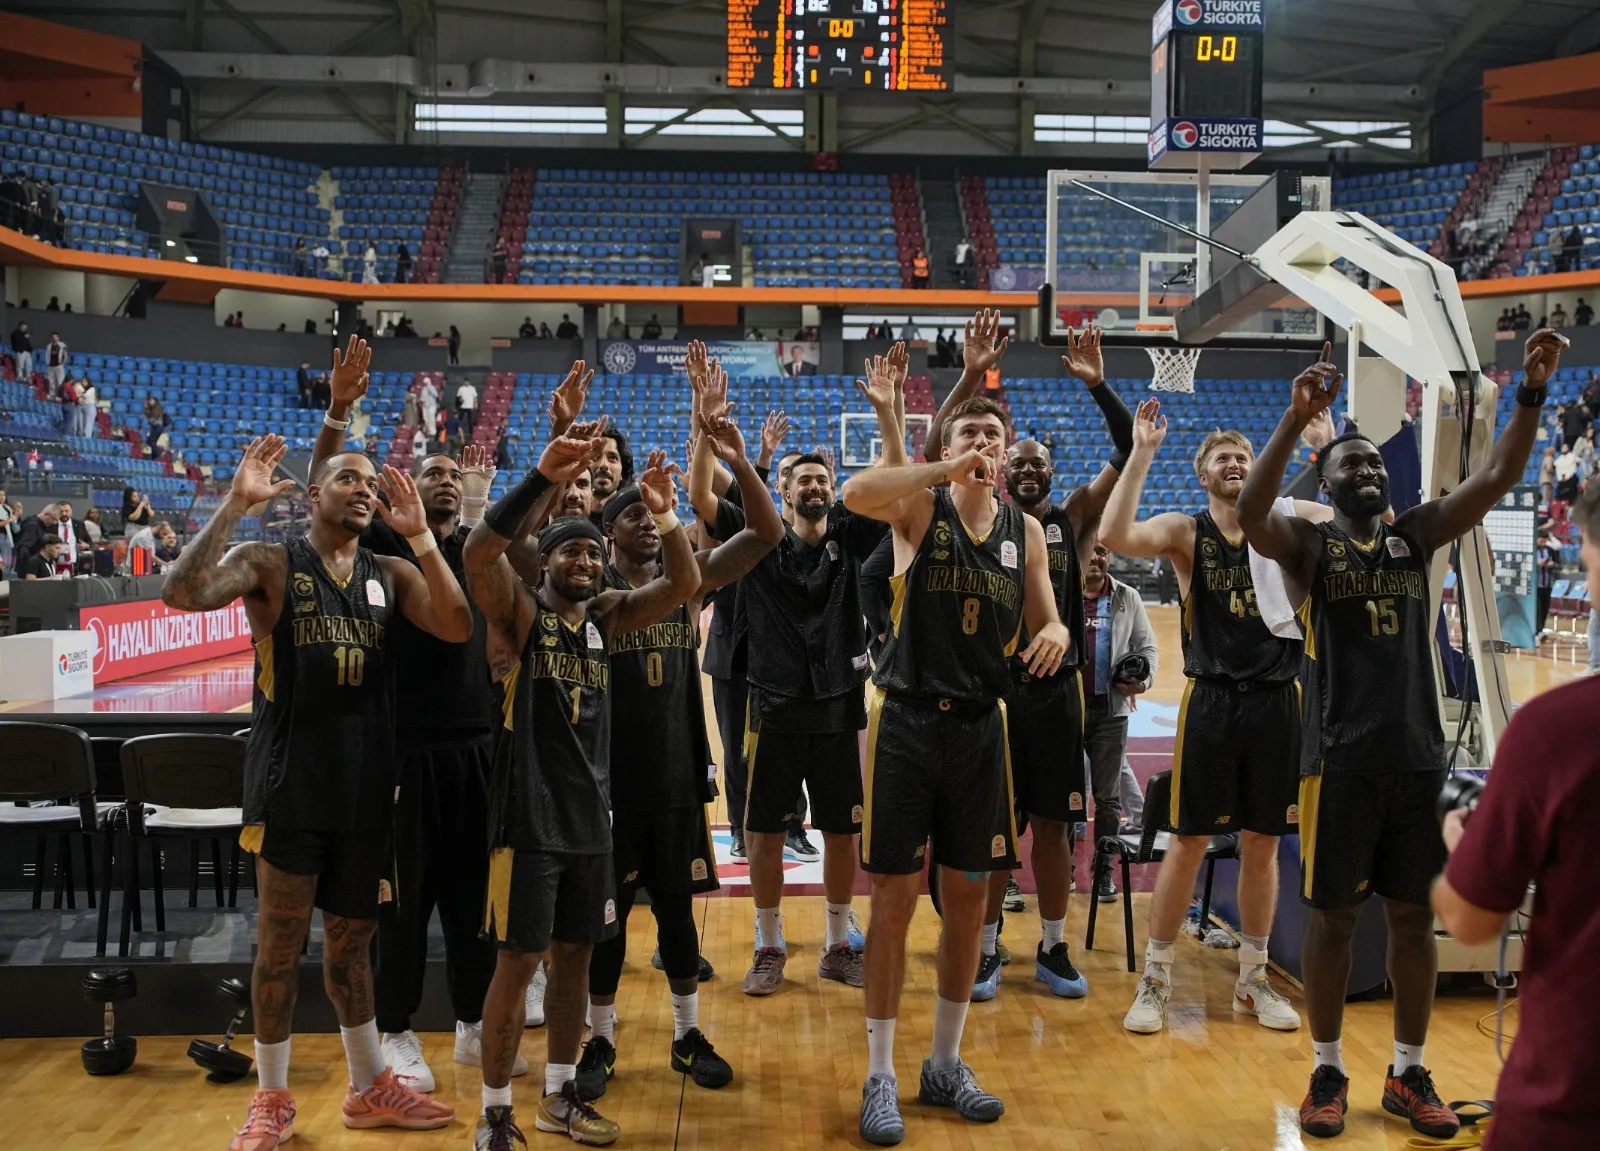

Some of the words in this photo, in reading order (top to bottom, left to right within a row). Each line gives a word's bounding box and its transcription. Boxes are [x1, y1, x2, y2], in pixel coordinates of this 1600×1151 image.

[1200, 136, 1257, 148] SİGORTA
[962, 597, 980, 635] 8
[1364, 598, 1399, 636] 15
[333, 646, 365, 687] 10
[647, 652, 663, 687] 0
[569, 687, 582, 725] 1
